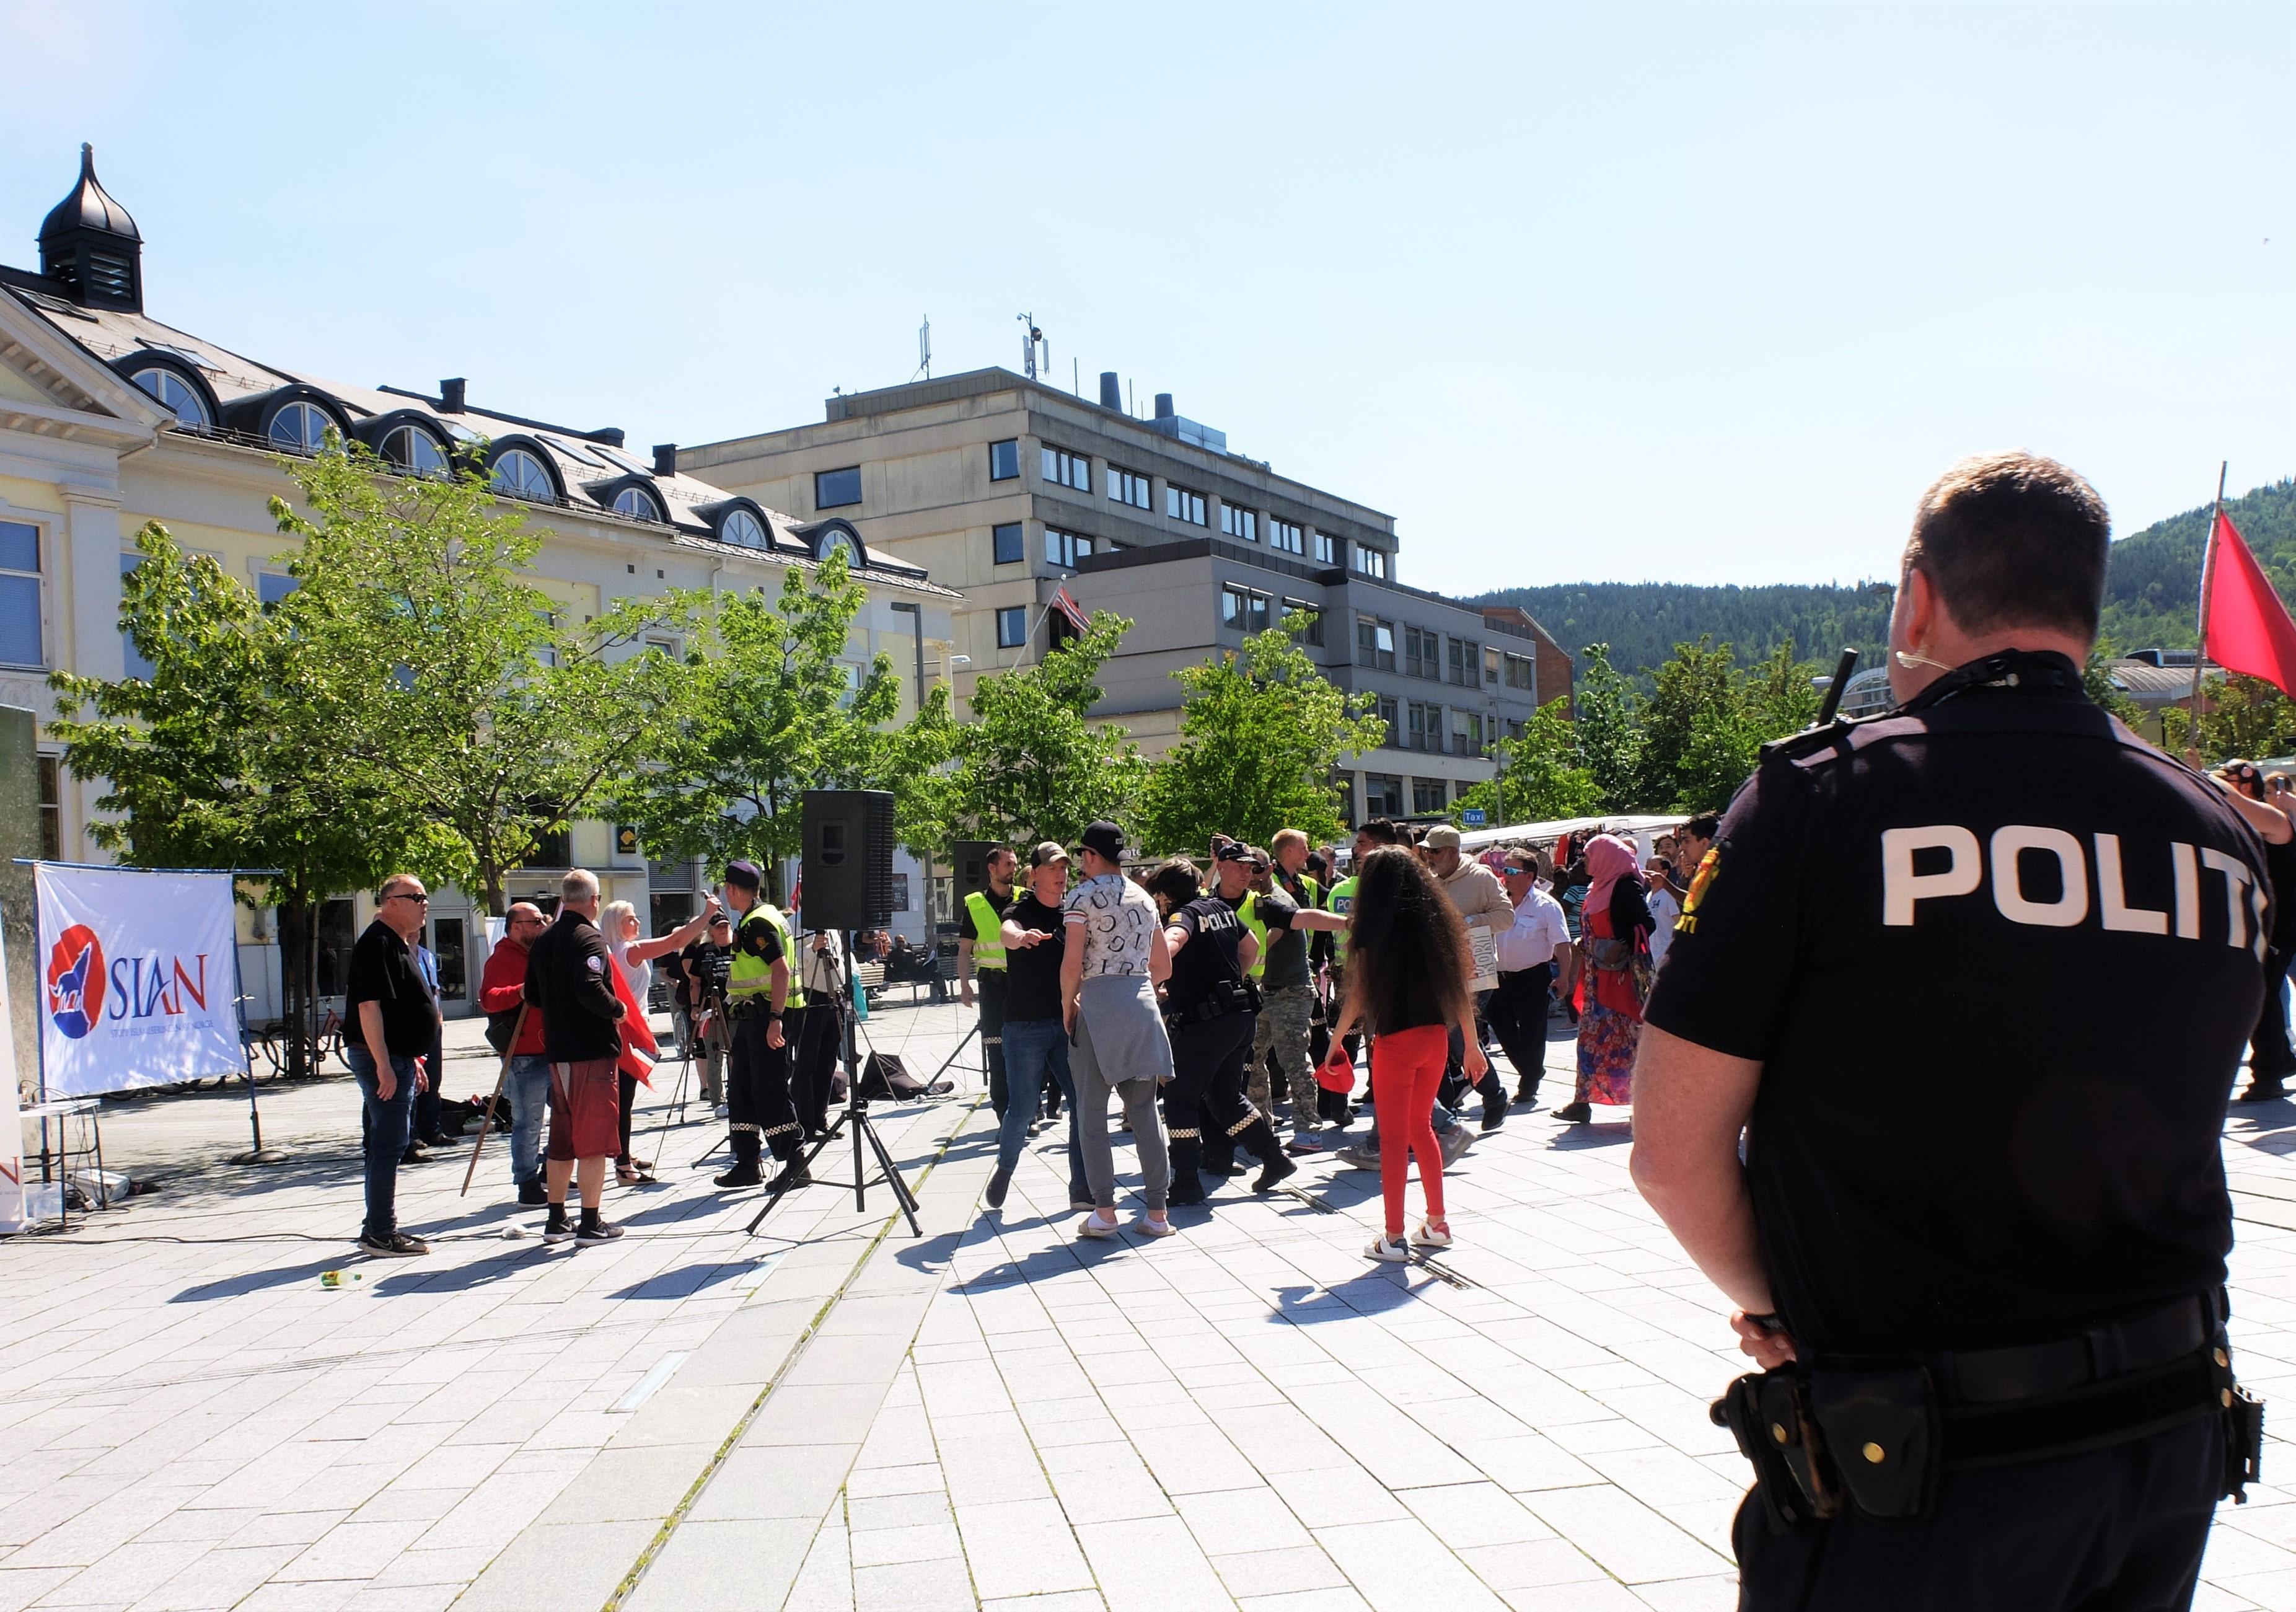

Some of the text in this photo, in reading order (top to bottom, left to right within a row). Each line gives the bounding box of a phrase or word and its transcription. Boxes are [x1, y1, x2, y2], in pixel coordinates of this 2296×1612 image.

[1466, 813, 1484, 821] Taxi
[1125, 848, 1142, 857] ate
[1198, 910, 1238, 933] POLIT
[109, 954, 208, 1020] SIAN
